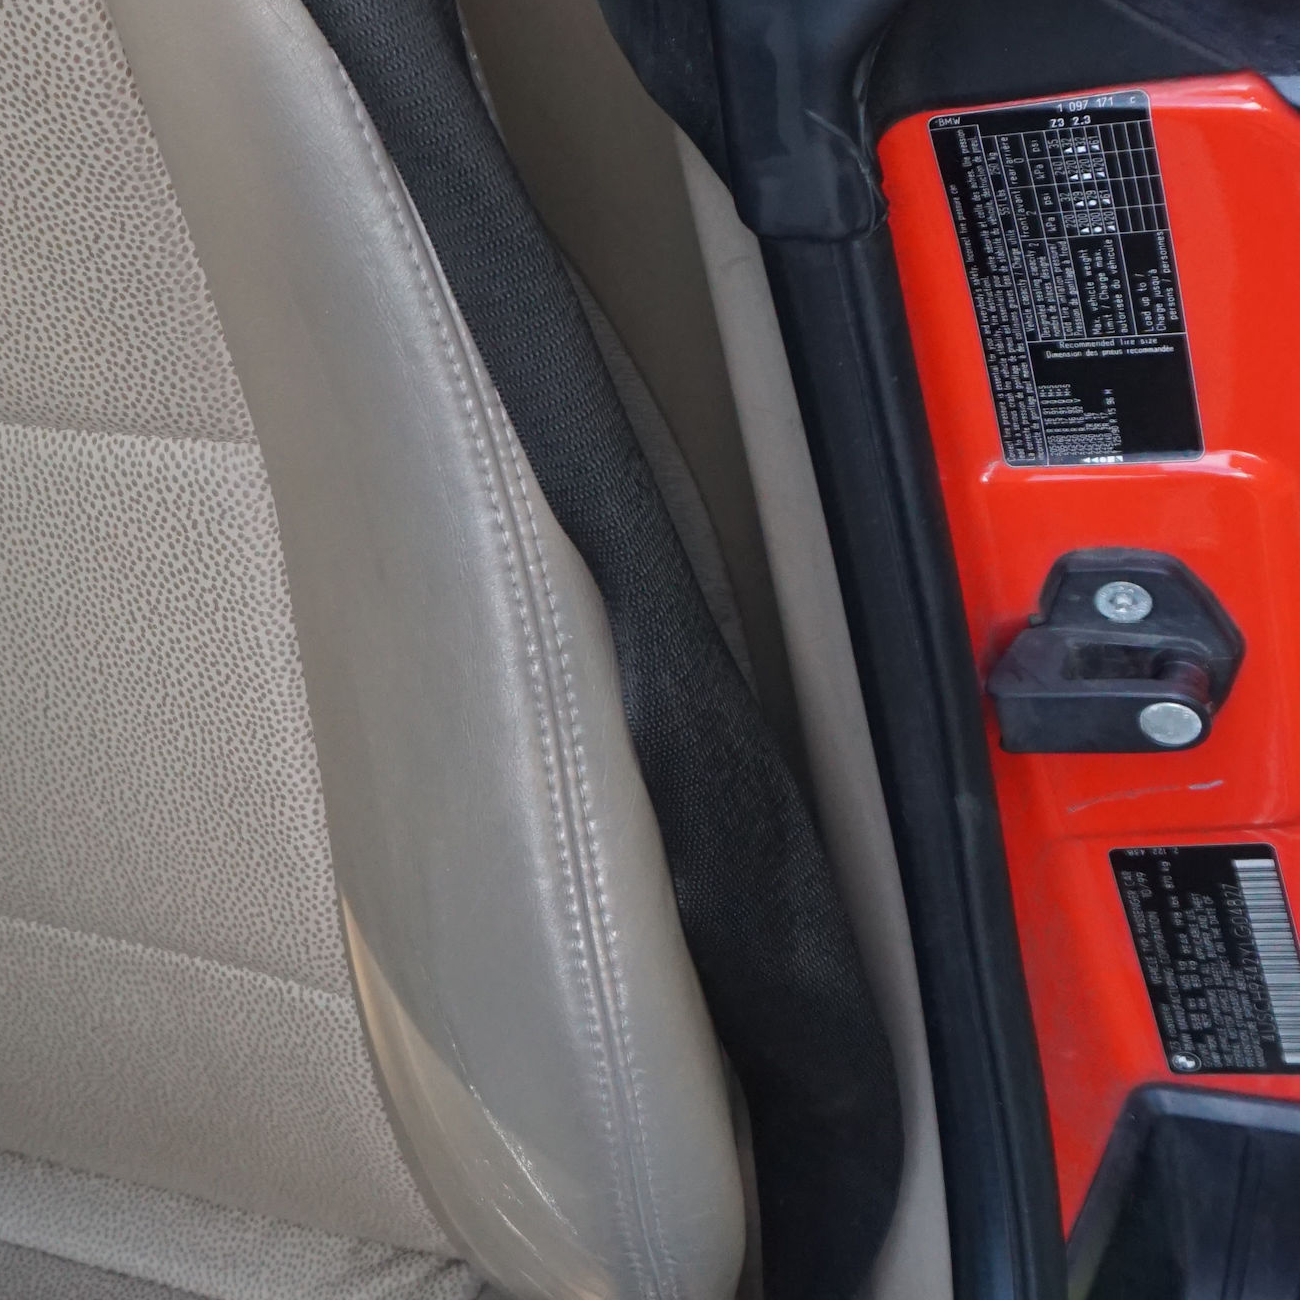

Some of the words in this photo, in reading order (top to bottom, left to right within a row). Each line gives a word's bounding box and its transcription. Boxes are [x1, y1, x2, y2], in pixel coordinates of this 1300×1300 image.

[1069, 100, 1089, 111] 097
[1096, 97, 1113, 107] 171
[939, 116, 961, 126] BMW
[1051, 118, 1065, 128] Z3
[1072, 115, 1091, 126] 2.3
[1095, 249, 1103, 267] max.
[1156, 230, 1172, 273] personnes
[1078, 249, 1092, 276] weight
[1097, 272, 1109, 300] Charge
[1111, 279, 1121, 289] du
[1137, 282, 1147, 291] to
[1085, 282, 1098, 311] vehicle
[1141, 297, 1150, 306] up
[1166, 287, 1179, 320] persons
[1092, 317, 1102, 335] Max.
[1103, 314, 1115, 334] limit
[1141, 311, 1154, 332] Load
[1155, 303, 1166, 331] Charge
